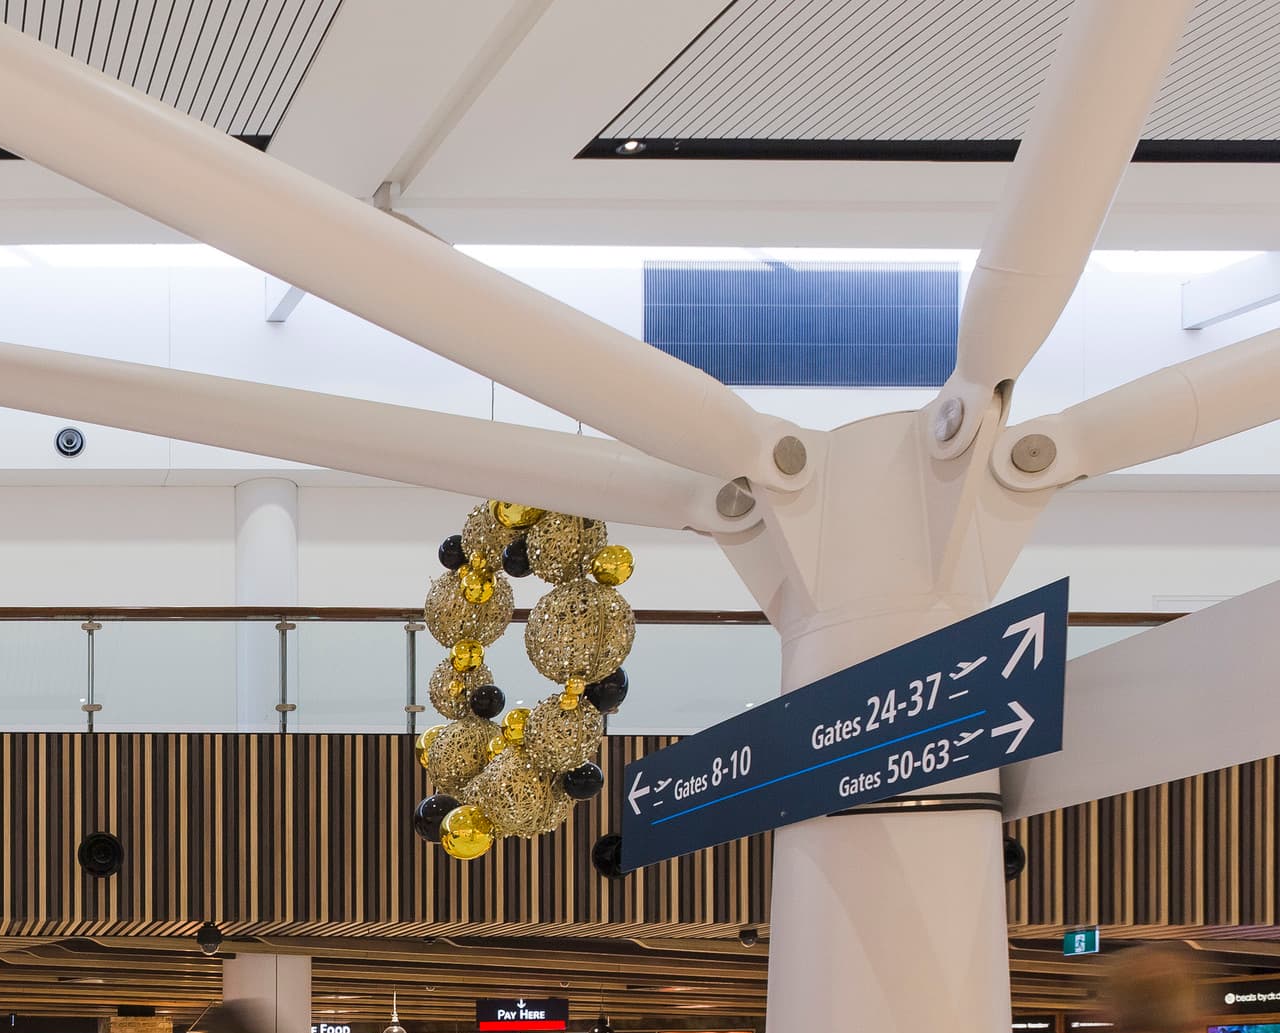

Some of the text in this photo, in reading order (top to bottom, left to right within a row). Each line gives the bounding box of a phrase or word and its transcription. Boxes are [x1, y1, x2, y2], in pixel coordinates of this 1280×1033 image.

[811, 671, 942, 750] Gates 24-37
[674, 745, 752, 801] Gates 8-10
[838, 738, 951, 798] Gates 50-63
